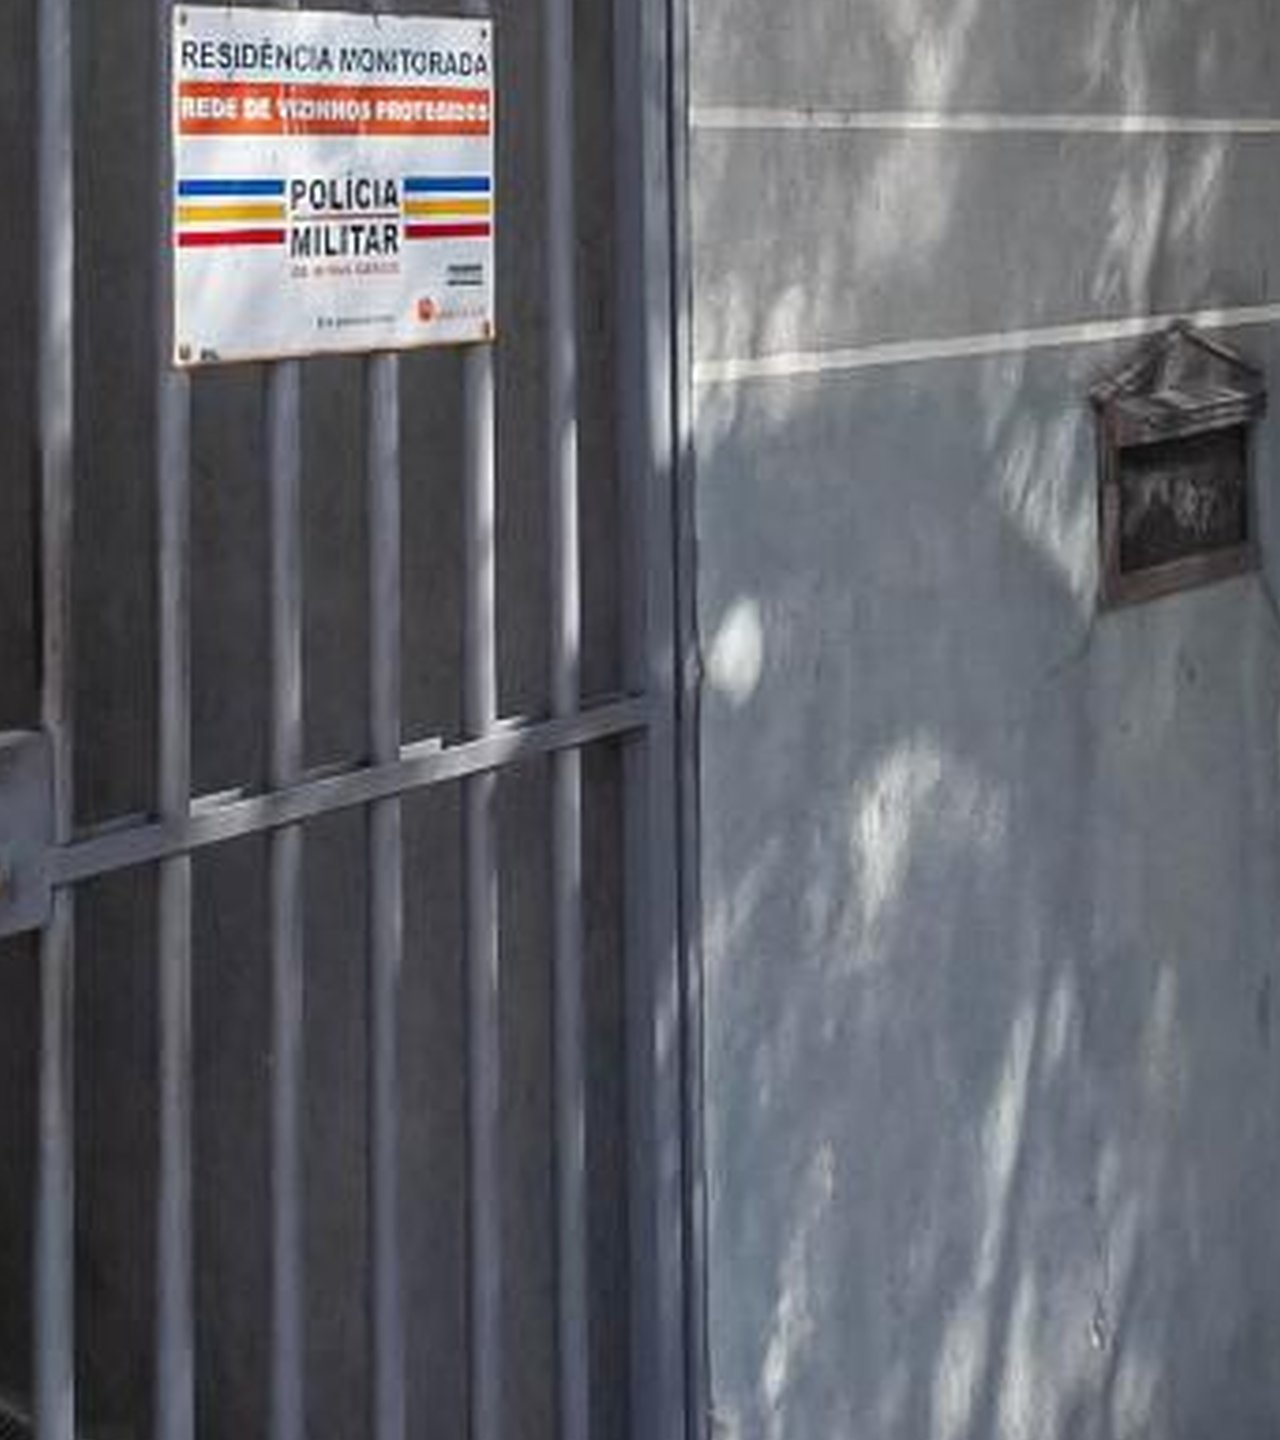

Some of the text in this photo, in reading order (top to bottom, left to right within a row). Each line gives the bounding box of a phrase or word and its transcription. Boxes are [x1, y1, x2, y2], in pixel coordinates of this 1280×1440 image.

[339, 47, 487, 75] MONITORADA
[181, 97, 236, 120] REDE
[243, 98, 271, 120] DE
[291, 172, 398, 209] POLÍCIA
[291, 225, 399, 257] MILITAR
